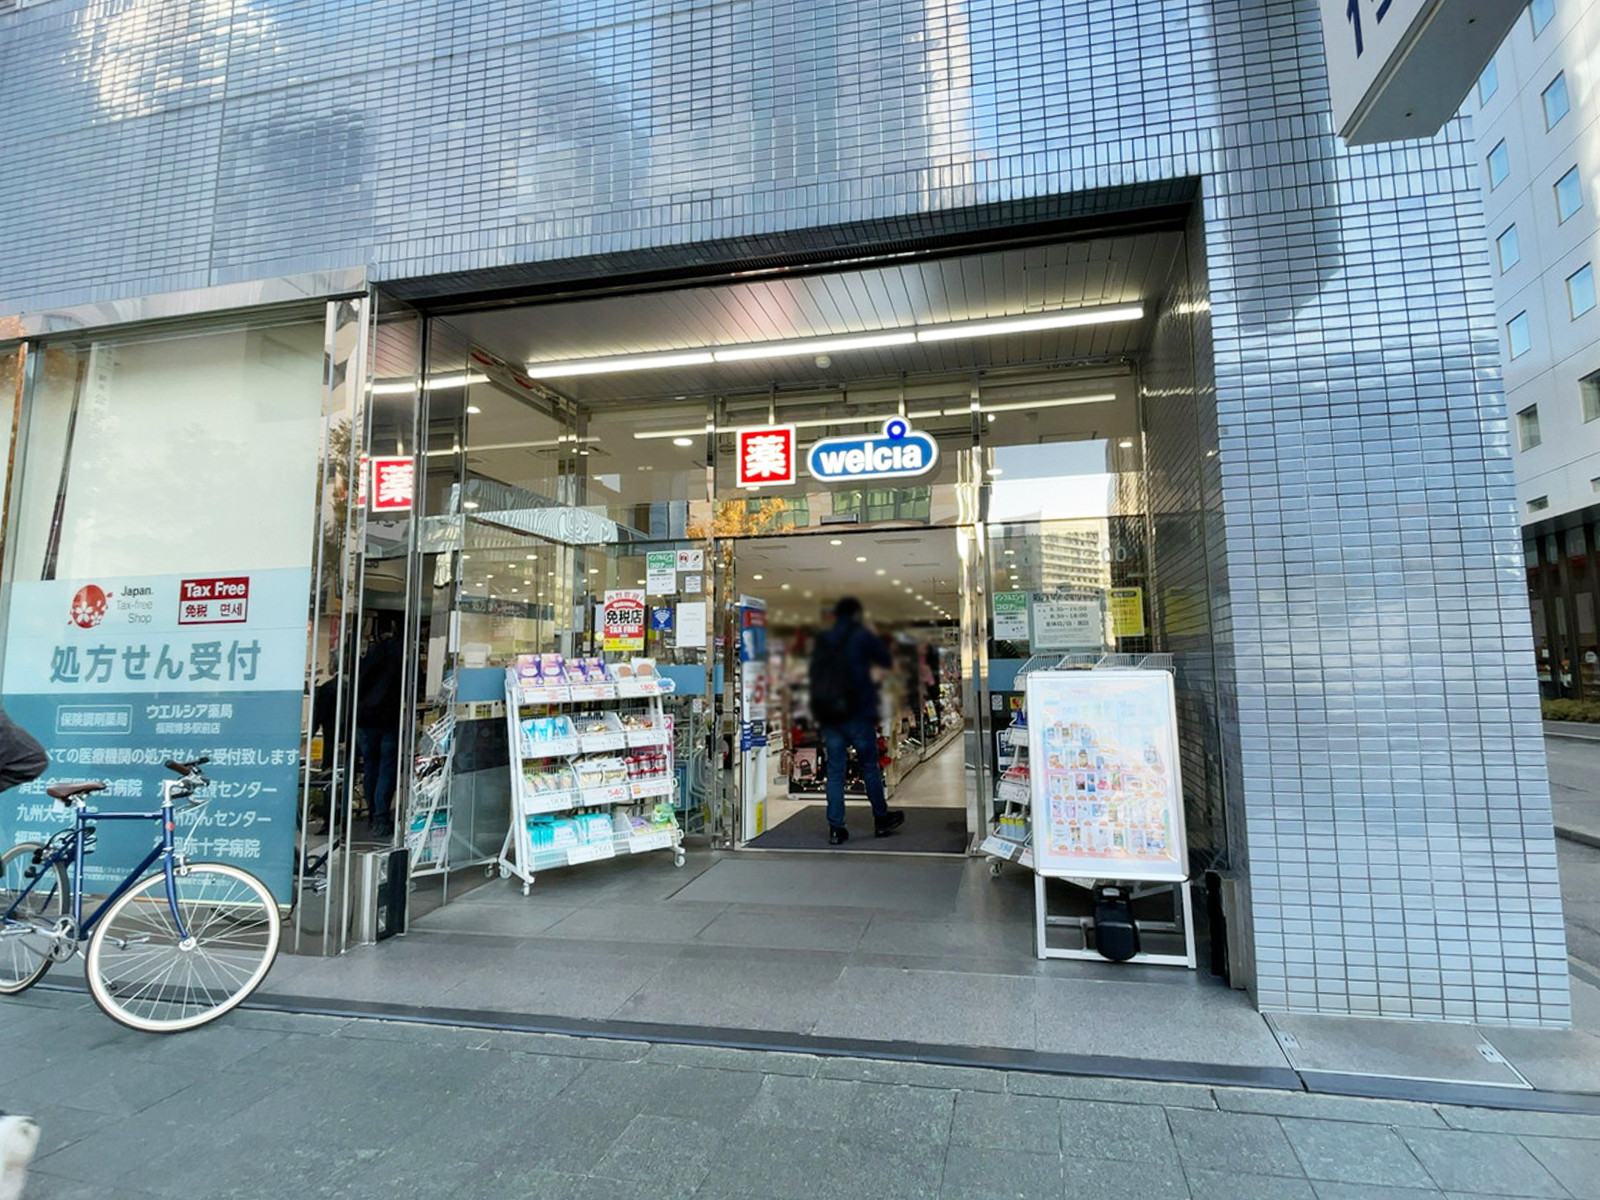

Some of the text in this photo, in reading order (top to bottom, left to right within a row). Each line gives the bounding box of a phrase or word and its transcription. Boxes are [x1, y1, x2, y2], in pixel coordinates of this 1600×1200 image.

[745, 435, 787, 477] 薬
[819, 442, 922, 475] welcia
[184, 582, 246, 598] Tax Free
[185, 603, 243, 618] 免税 면세
[606, 610, 642, 624] 免税店
[127, 613, 152, 625] Shop
[50, 639, 261, 683] 処方せん受付
